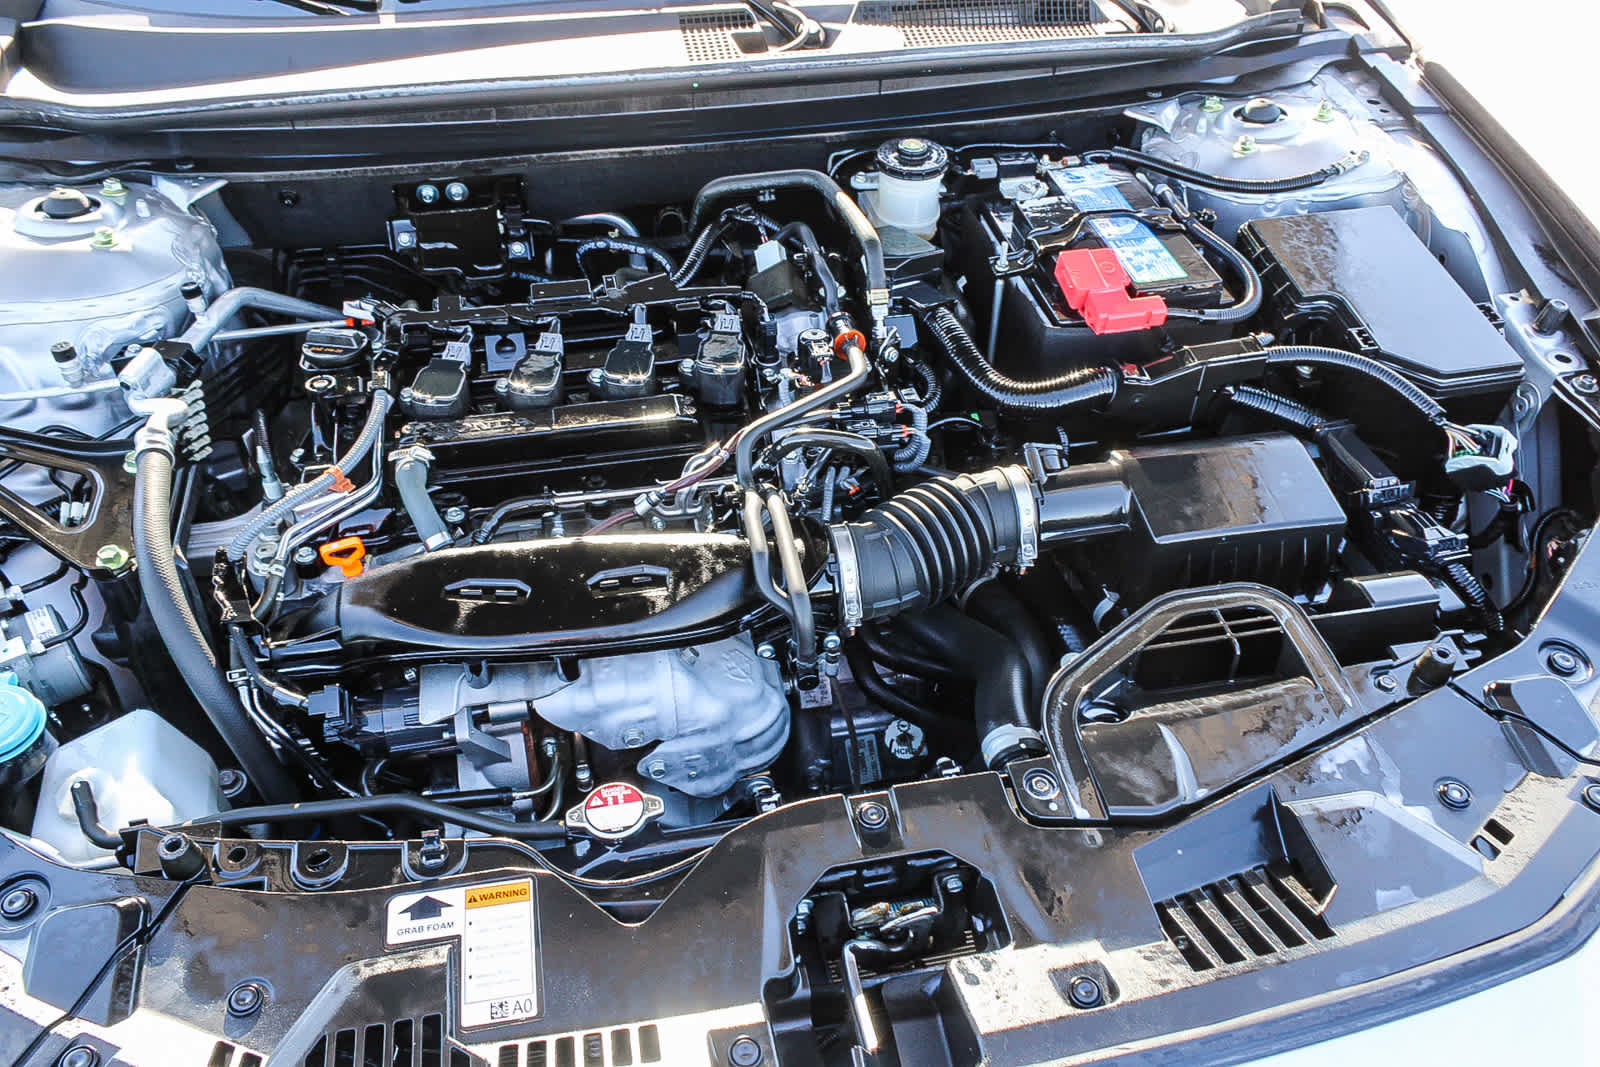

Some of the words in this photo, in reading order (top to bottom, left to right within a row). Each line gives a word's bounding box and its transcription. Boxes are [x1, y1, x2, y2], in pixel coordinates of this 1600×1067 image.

[478, 888, 528, 902] WARNING
[396, 924, 425, 937] GRAB
[426, 921, 455, 933] FOAM
